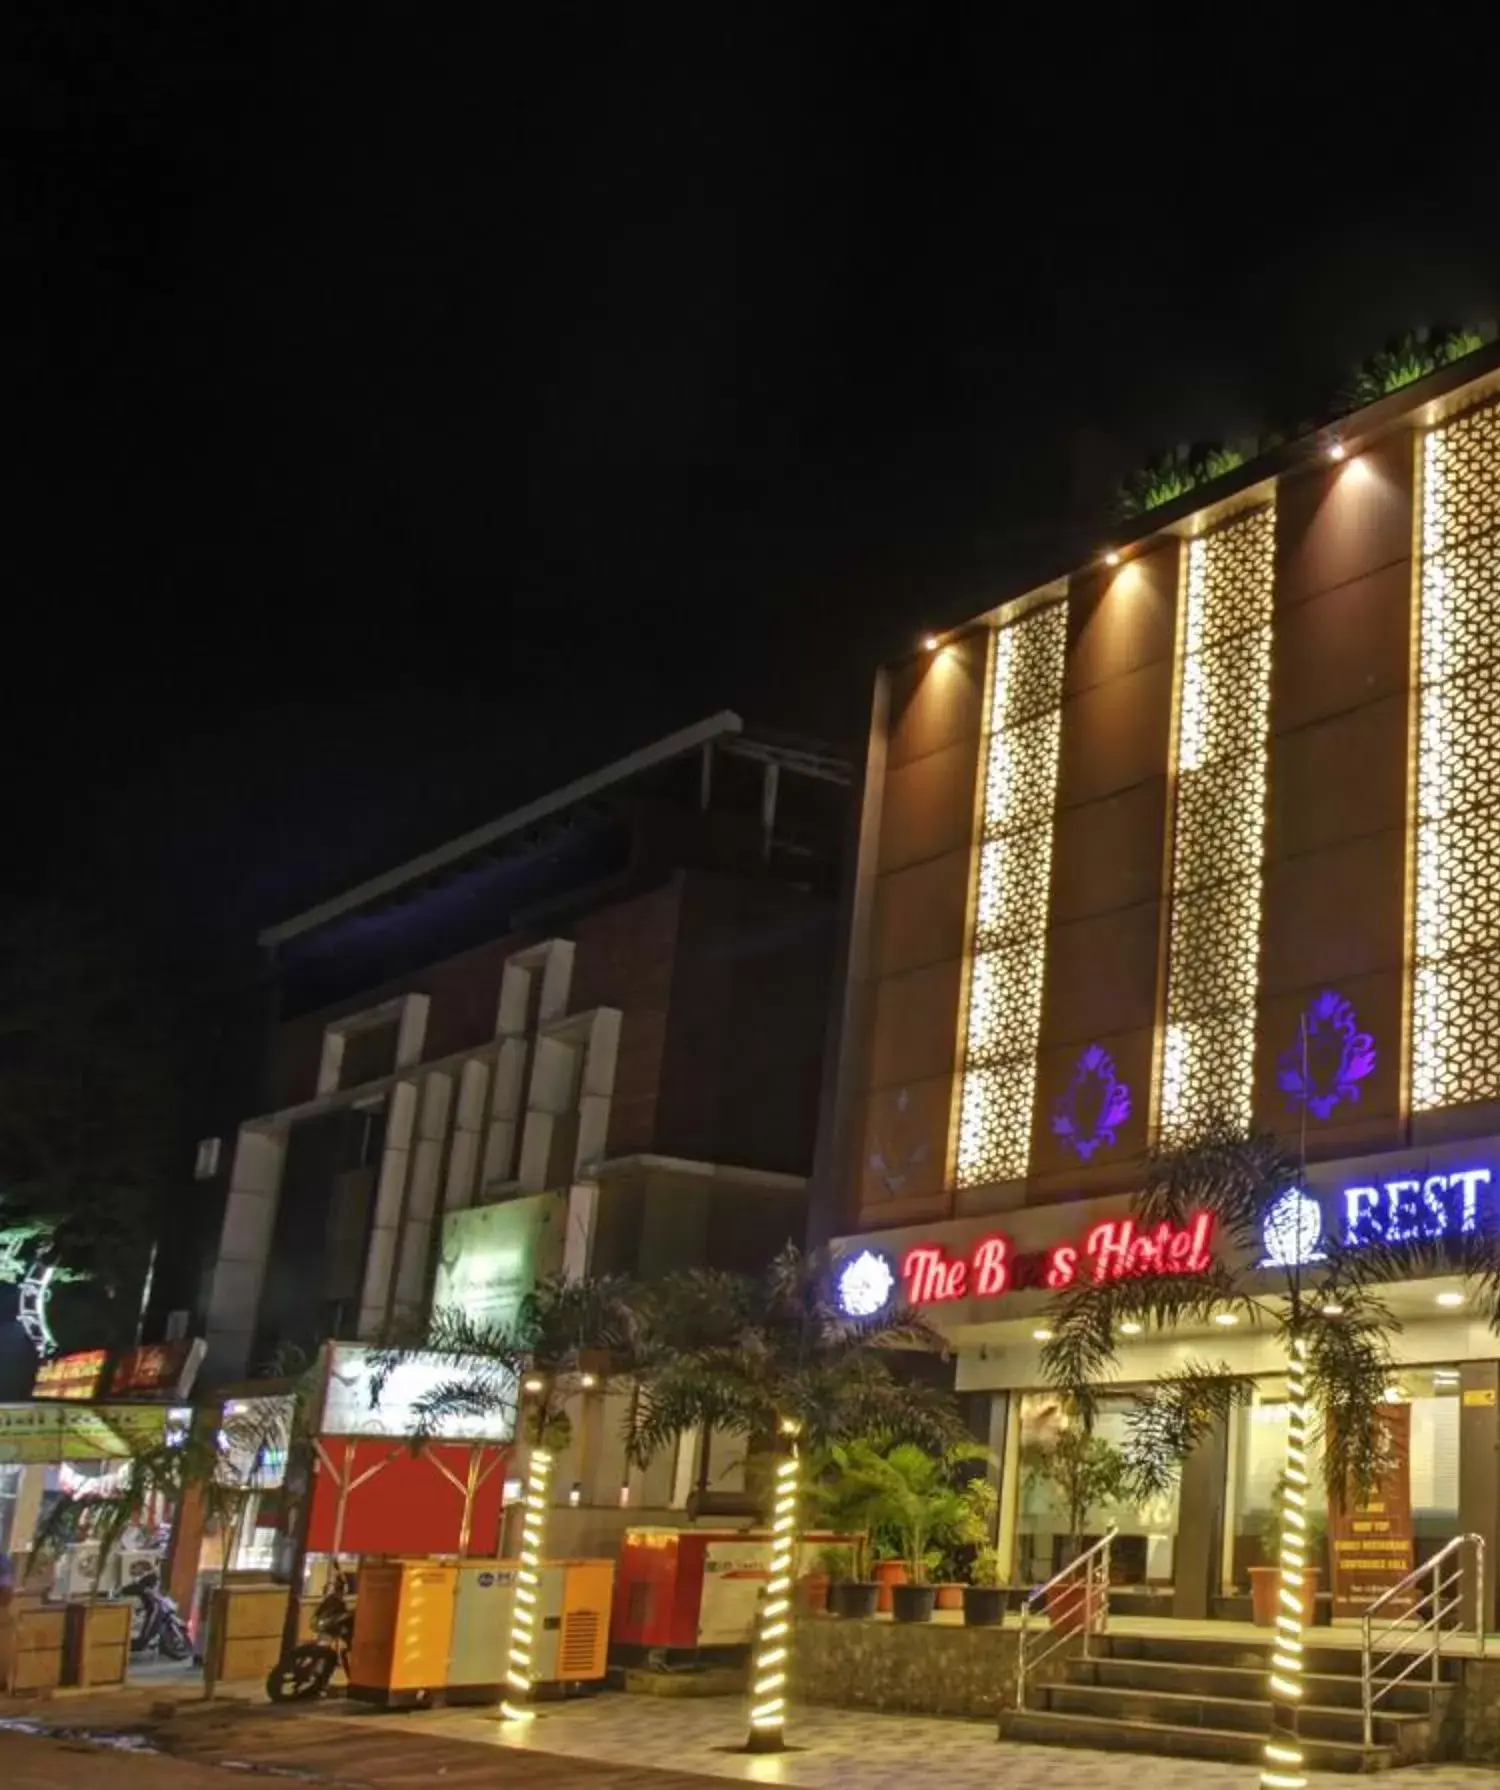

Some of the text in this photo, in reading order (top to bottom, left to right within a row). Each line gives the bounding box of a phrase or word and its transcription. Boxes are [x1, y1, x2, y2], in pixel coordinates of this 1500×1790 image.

[903, 1212, 1211, 1304] The Bs Hotel
